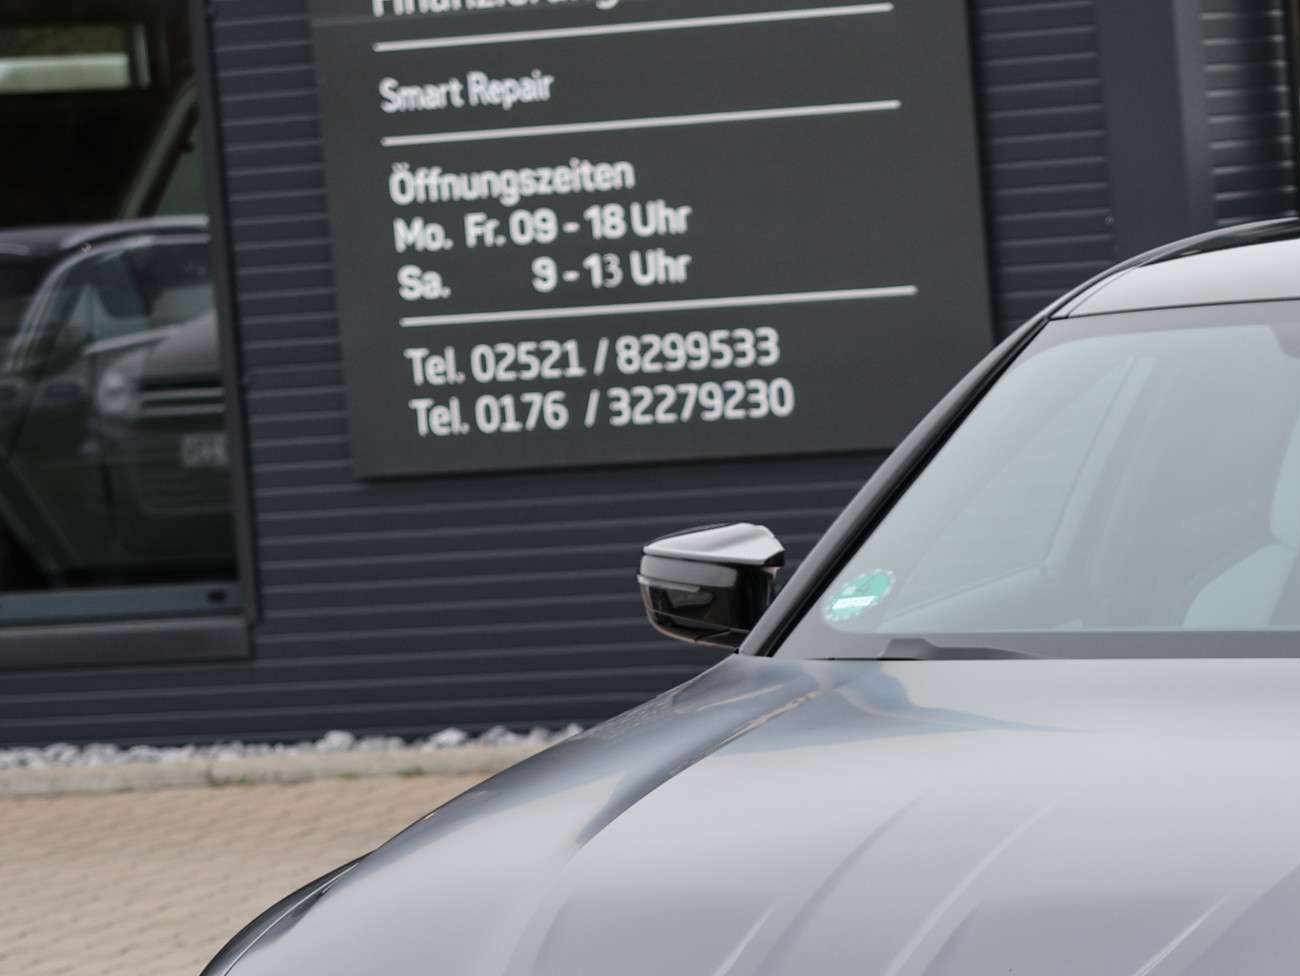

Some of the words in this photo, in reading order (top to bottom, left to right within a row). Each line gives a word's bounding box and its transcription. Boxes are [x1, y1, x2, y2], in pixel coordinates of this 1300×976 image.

[378, 77, 465, 113] Smart
[466, 69, 554, 110] Repair
[389, 157, 636, 206] Öffnungszeiten
[393, 217, 453, 253] Mo.
[464, 212, 506, 248] Fr.
[509, 208, 558, 246] 09
[562, 222, 580, 233] -
[584, 203, 627, 240] 18
[630, 199, 692, 237] Uhr
[397, 265, 451, 301] Sa.
[531, 256, 558, 293] 9
[562, 270, 580, 282] -
[583, 253, 624, 288] 13
[630, 248, 692, 286] Uhr
[403, 346, 466, 386] Tel.
[470, 339, 587, 383] 02521
[593, 337, 609, 376] /
[615, 326, 781, 374] 8299533
[408, 396, 470, 437] Tel.
[475, 390, 569, 435] 0176
[584, 389, 600, 427] /
[607, 377, 795, 427] 32279230
